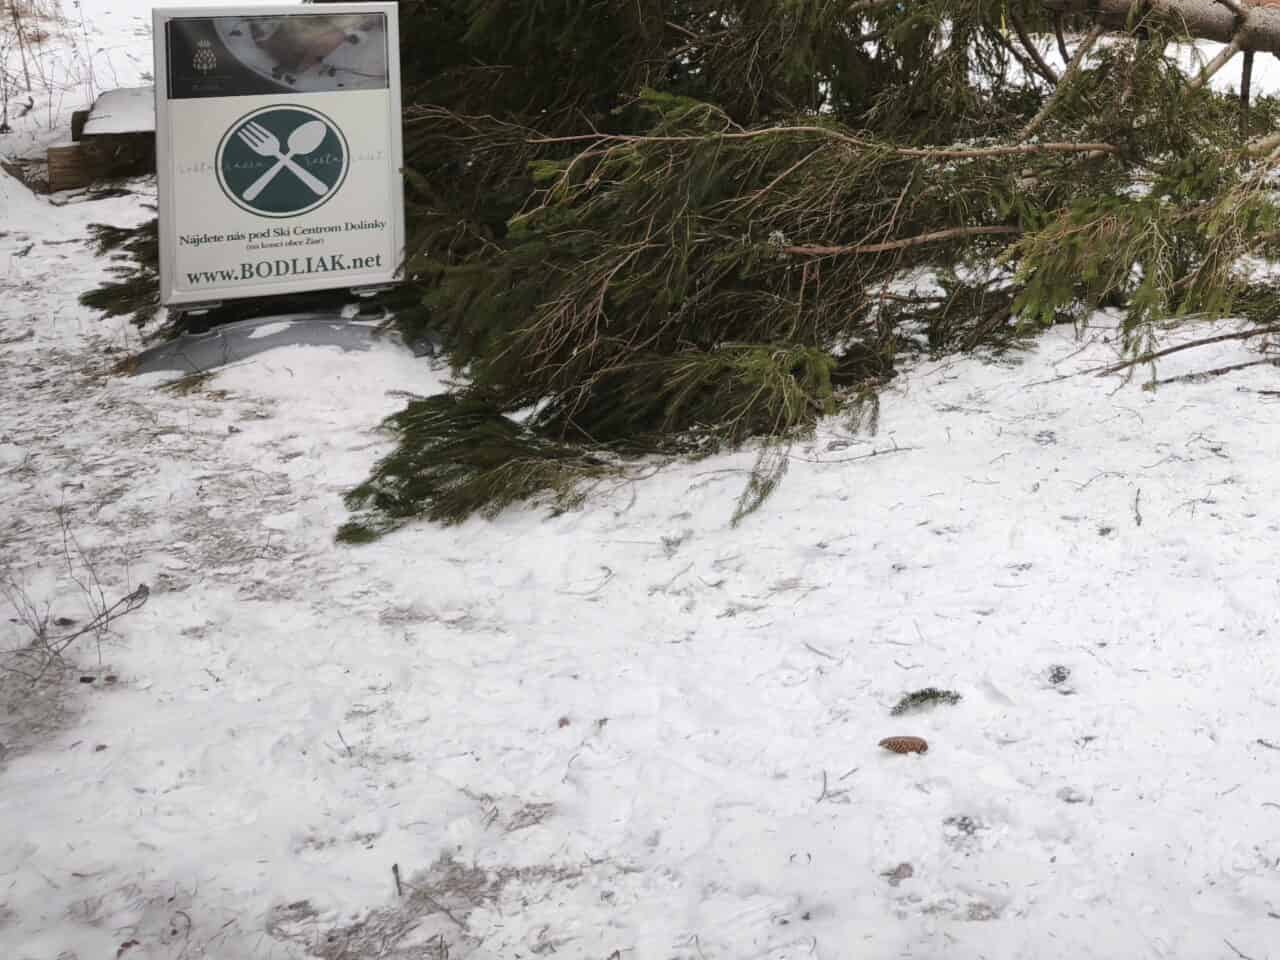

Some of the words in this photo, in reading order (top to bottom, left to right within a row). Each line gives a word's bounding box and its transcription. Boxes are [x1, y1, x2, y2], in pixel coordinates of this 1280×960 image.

[226, 232, 246, 242] nás
[248, 227, 271, 242] pod
[273, 227, 291, 238] Ski
[293, 223, 342, 236] Centrom
[186, 253, 383, 285] www.BODLIAK.net
